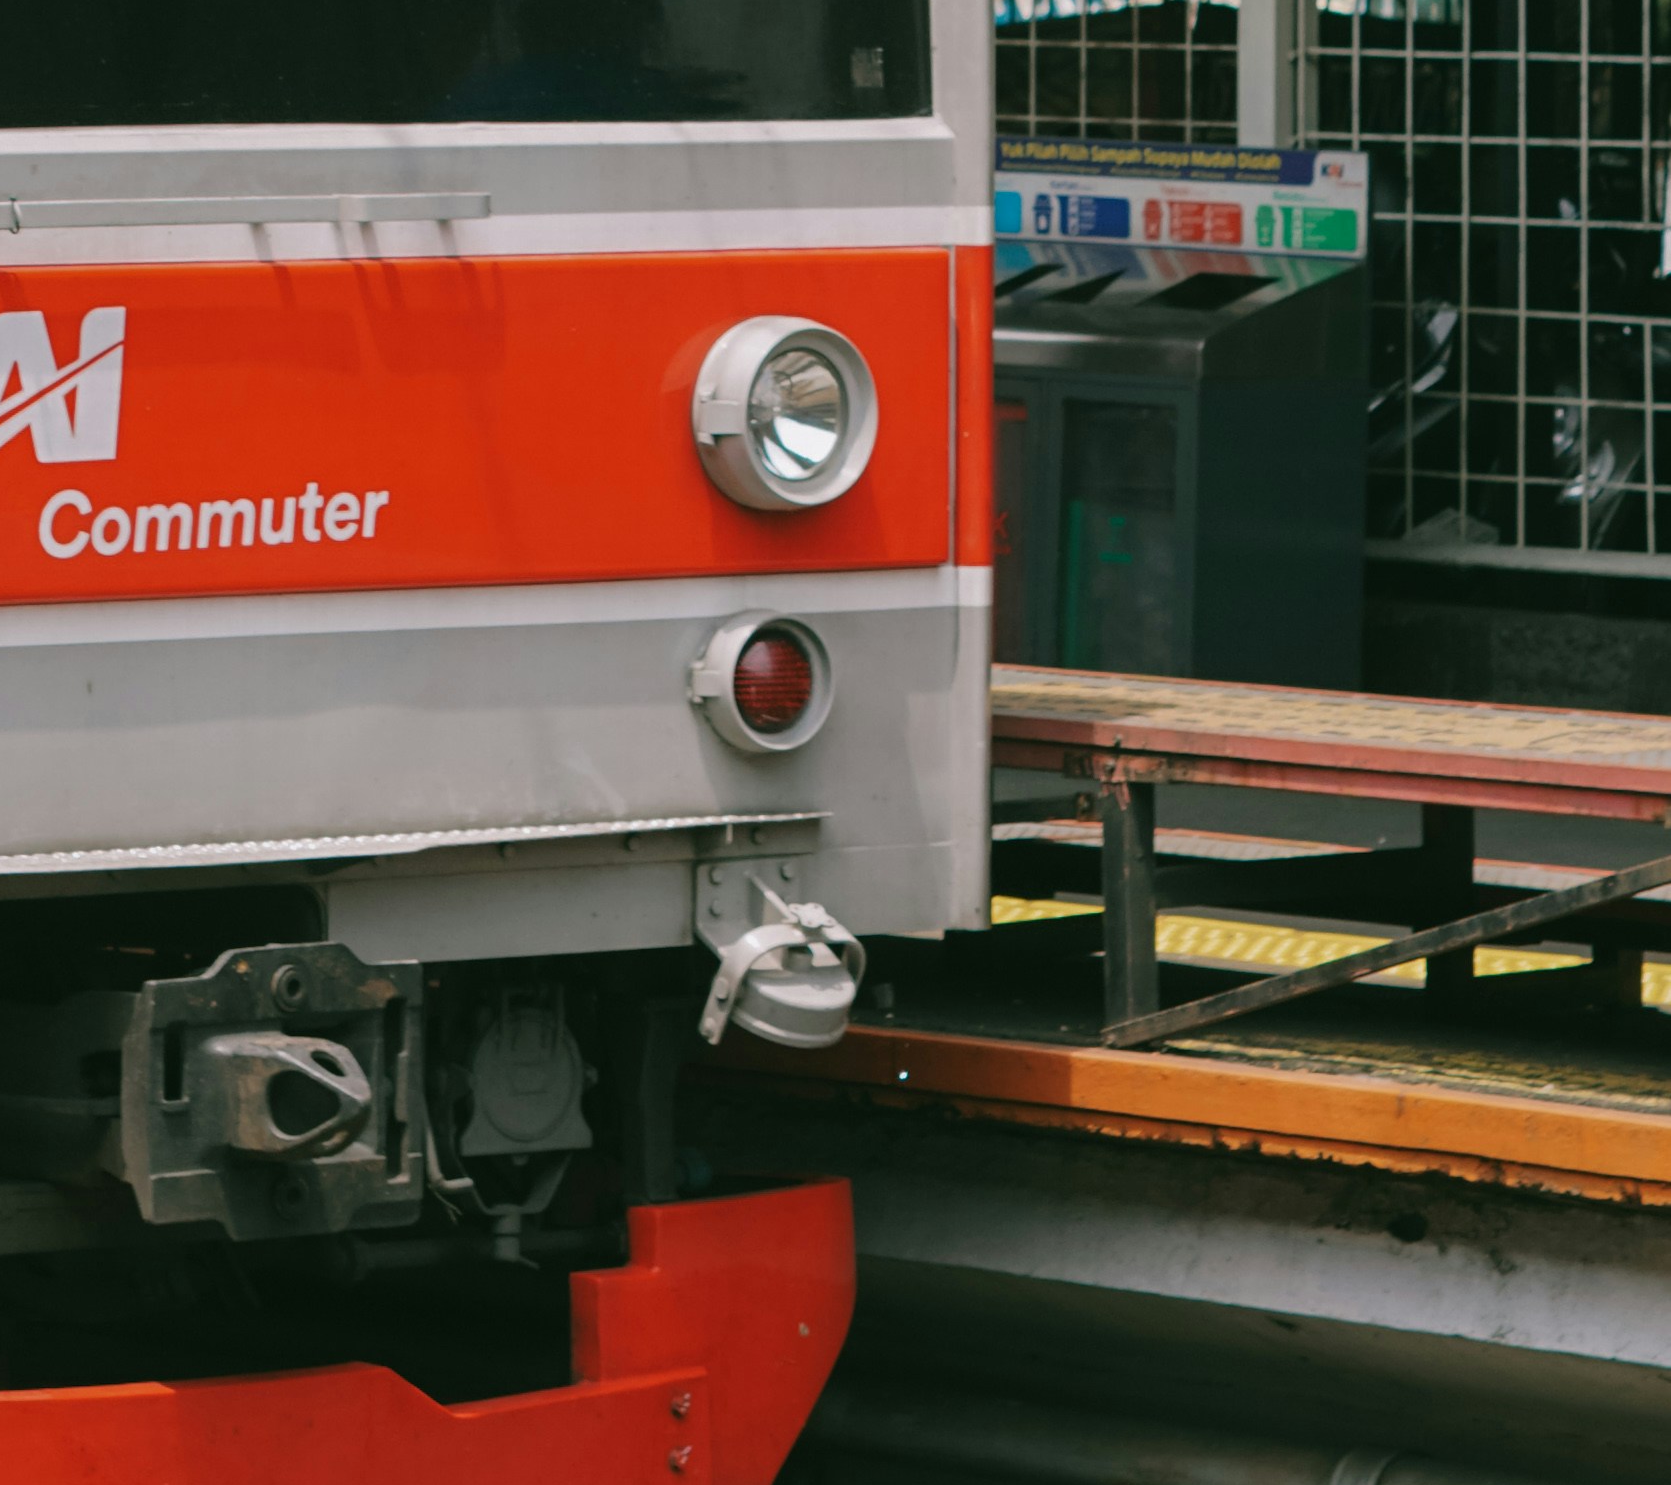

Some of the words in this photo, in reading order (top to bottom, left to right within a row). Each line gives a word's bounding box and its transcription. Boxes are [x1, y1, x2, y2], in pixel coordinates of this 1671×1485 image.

[1001, 142, 1024, 158] Yuk
[1091, 145, 1142, 165] Sampah
[1143, 147, 1189, 168] Supaya
[1191, 151, 1236, 169] Mudah
[39, 482, 389, 559] Commuter
